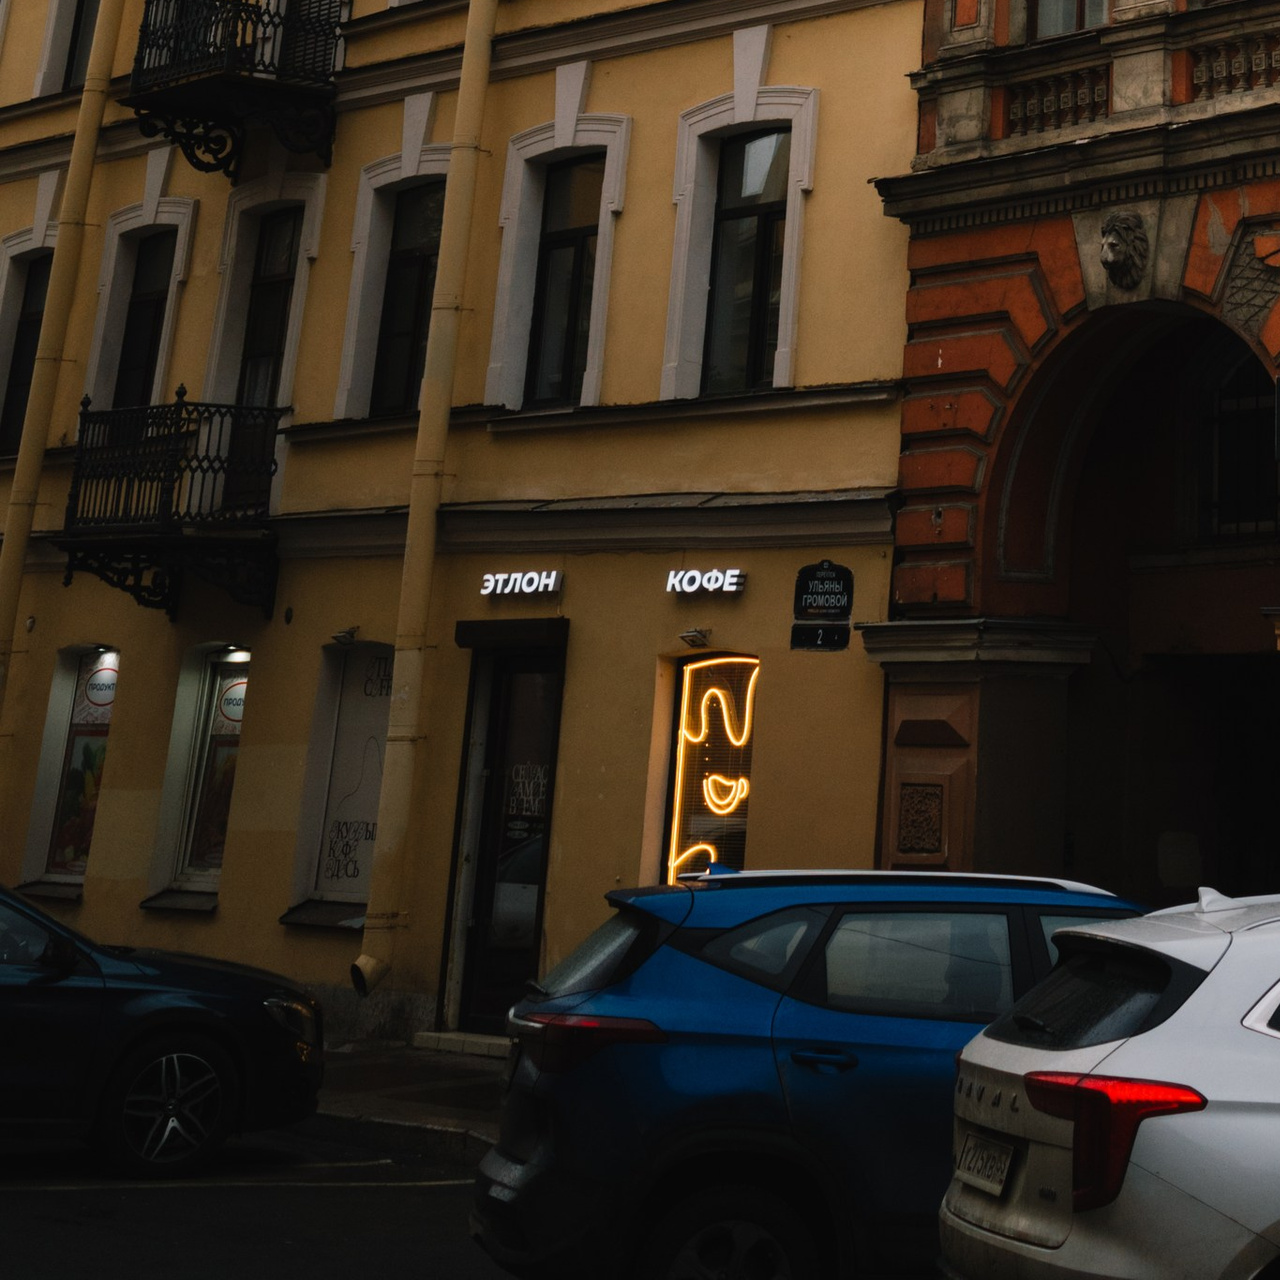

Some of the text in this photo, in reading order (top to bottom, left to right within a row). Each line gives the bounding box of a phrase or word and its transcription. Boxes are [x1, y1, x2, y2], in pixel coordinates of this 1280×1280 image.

[480, 569, 559, 595] ЭТЛОН
[666, 568, 742, 593] КОФЕ
[808, 580, 844, 592] УЛЬЯНЫ
[802, 592, 848, 607] ГРОМОВОЙ
[816, 628, 823, 645] 2
[329, 819, 378, 841] ВКУСНЫ
